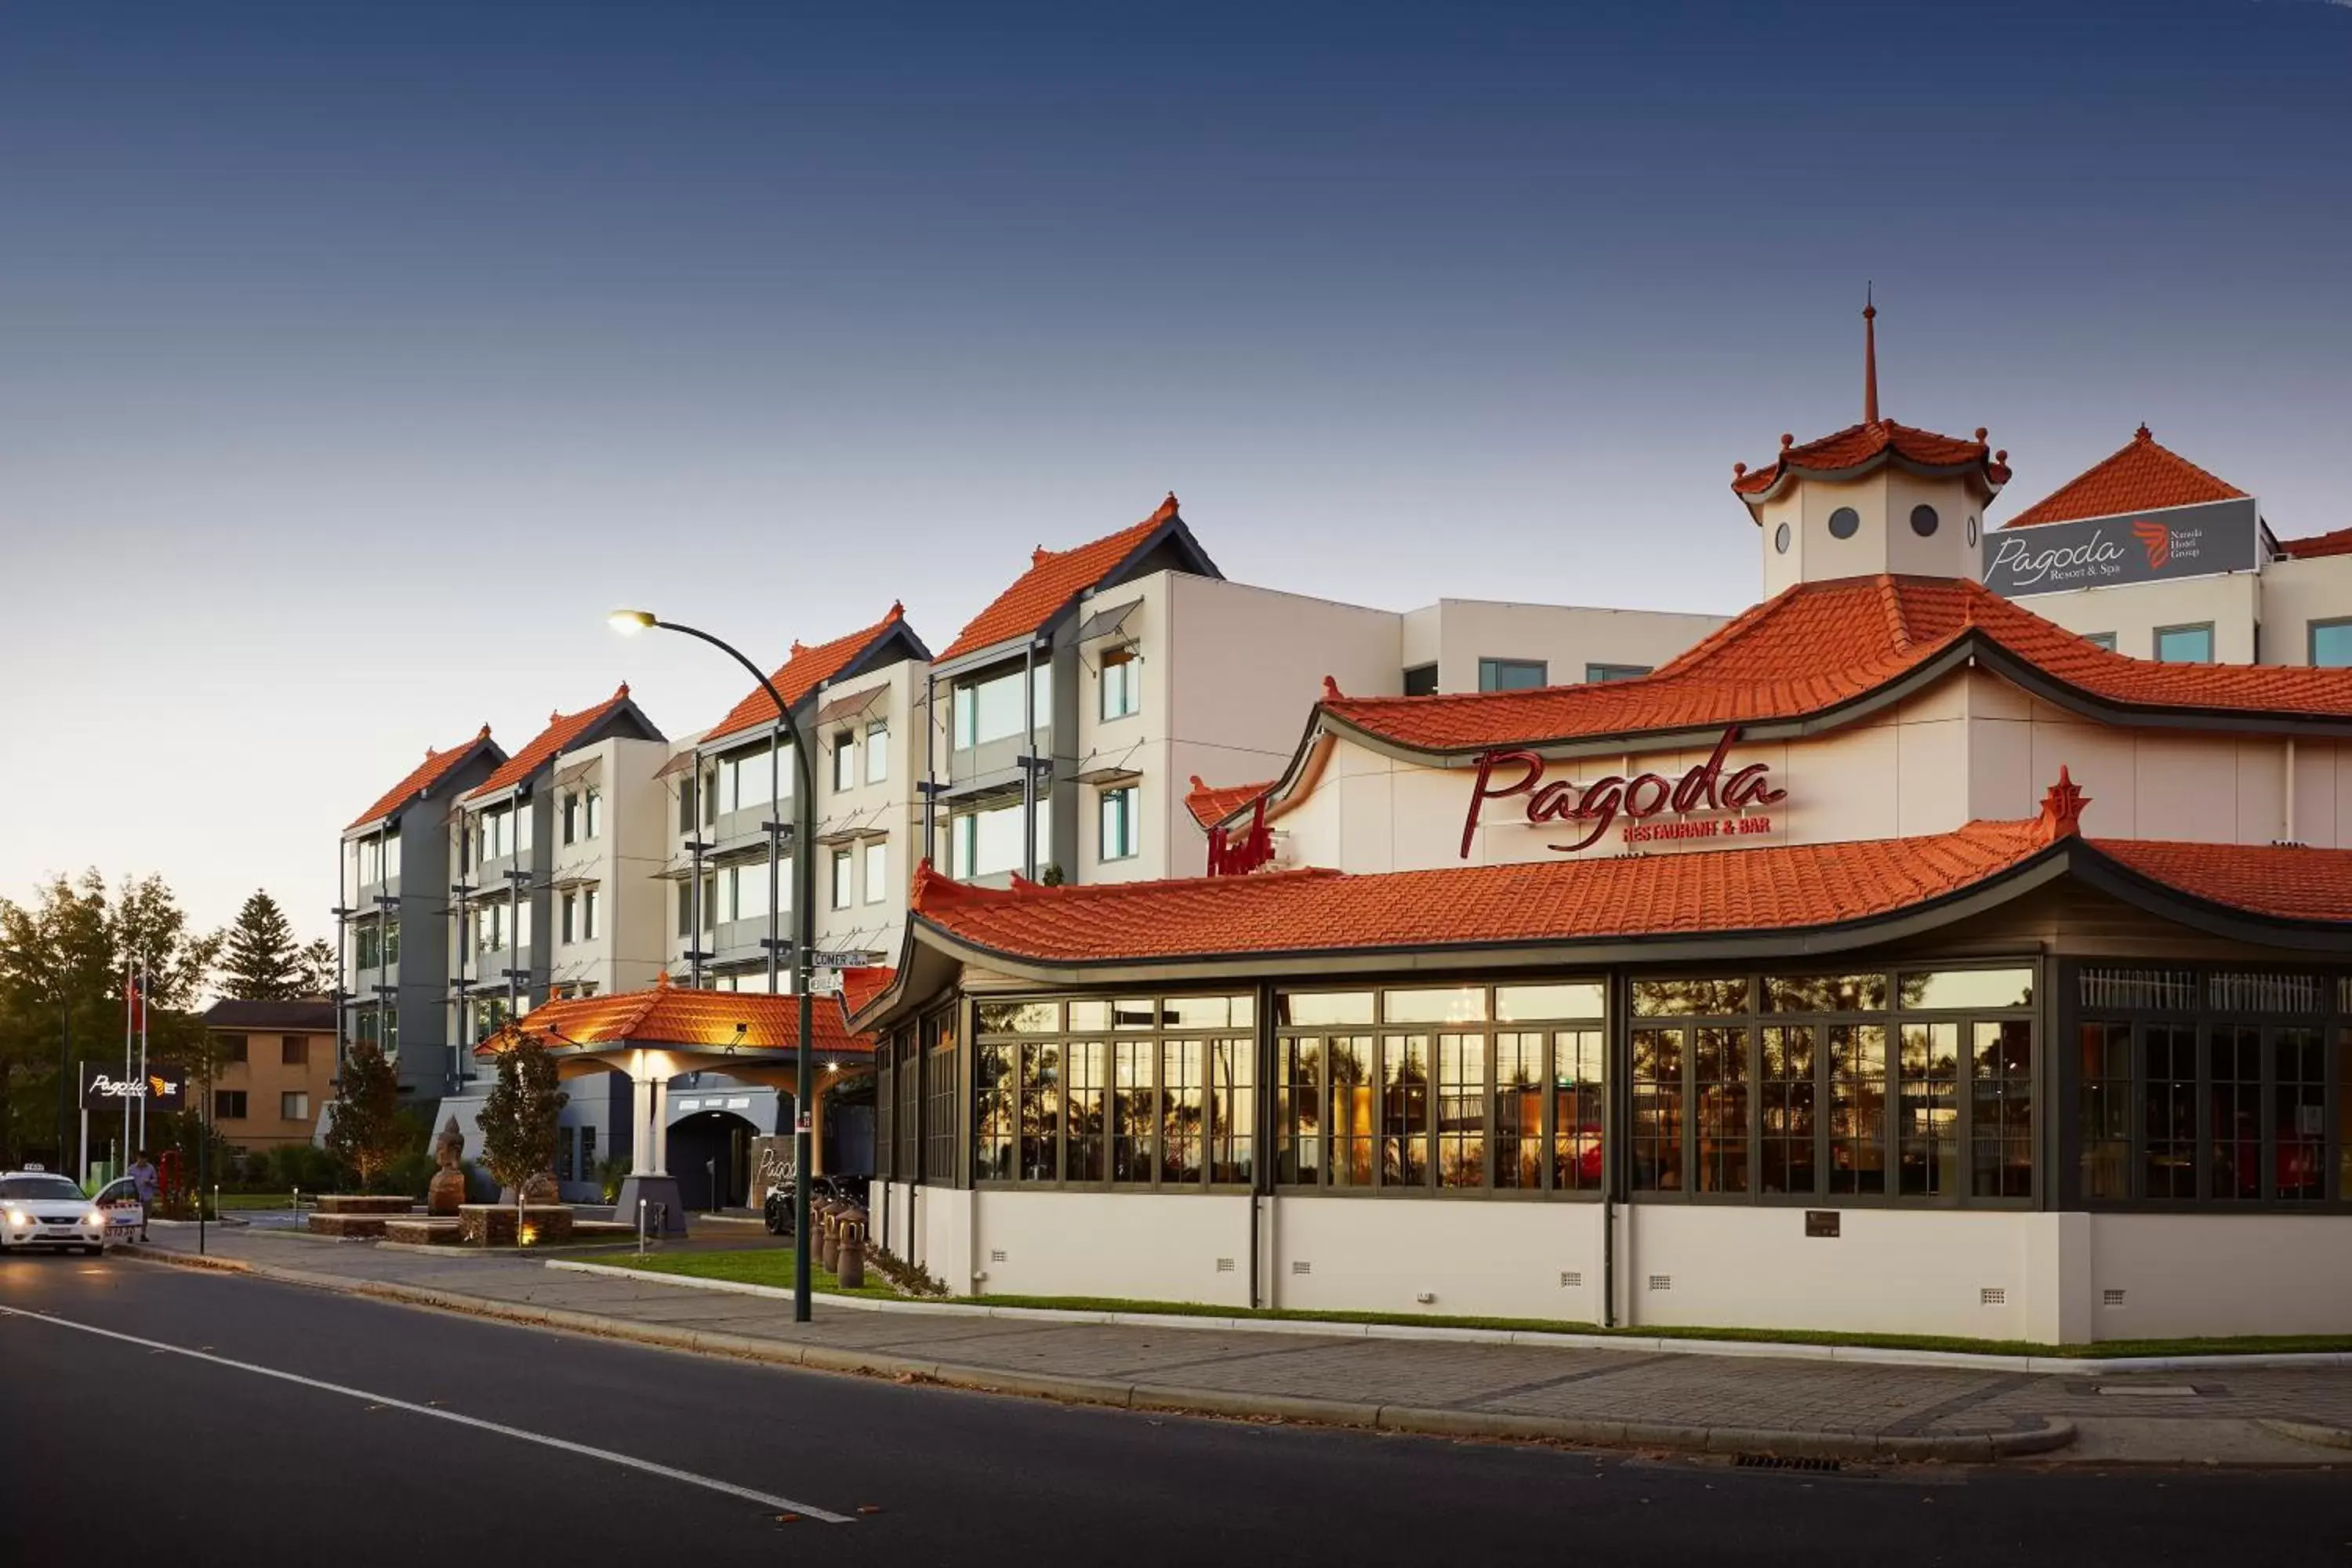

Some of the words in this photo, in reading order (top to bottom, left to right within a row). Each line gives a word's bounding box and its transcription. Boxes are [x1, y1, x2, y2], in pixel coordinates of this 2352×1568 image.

[1983, 529, 2125, 586] Pagoda
[2171, 548, 2200, 559] Group
[2050, 568, 2085, 580] Resort
[2087, 564, 2096, 576] &
[2100, 564, 2121, 576] Spa
[1460, 725, 1788, 858] Pagoda
[1622, 820, 1719, 843] RESTAURANT
[1722, 818, 1735, 836] &
[1738, 817, 1772, 835] BAR
[89, 1074, 147, 1096] Pagoda
[757, 1148, 798, 1181] Pago
